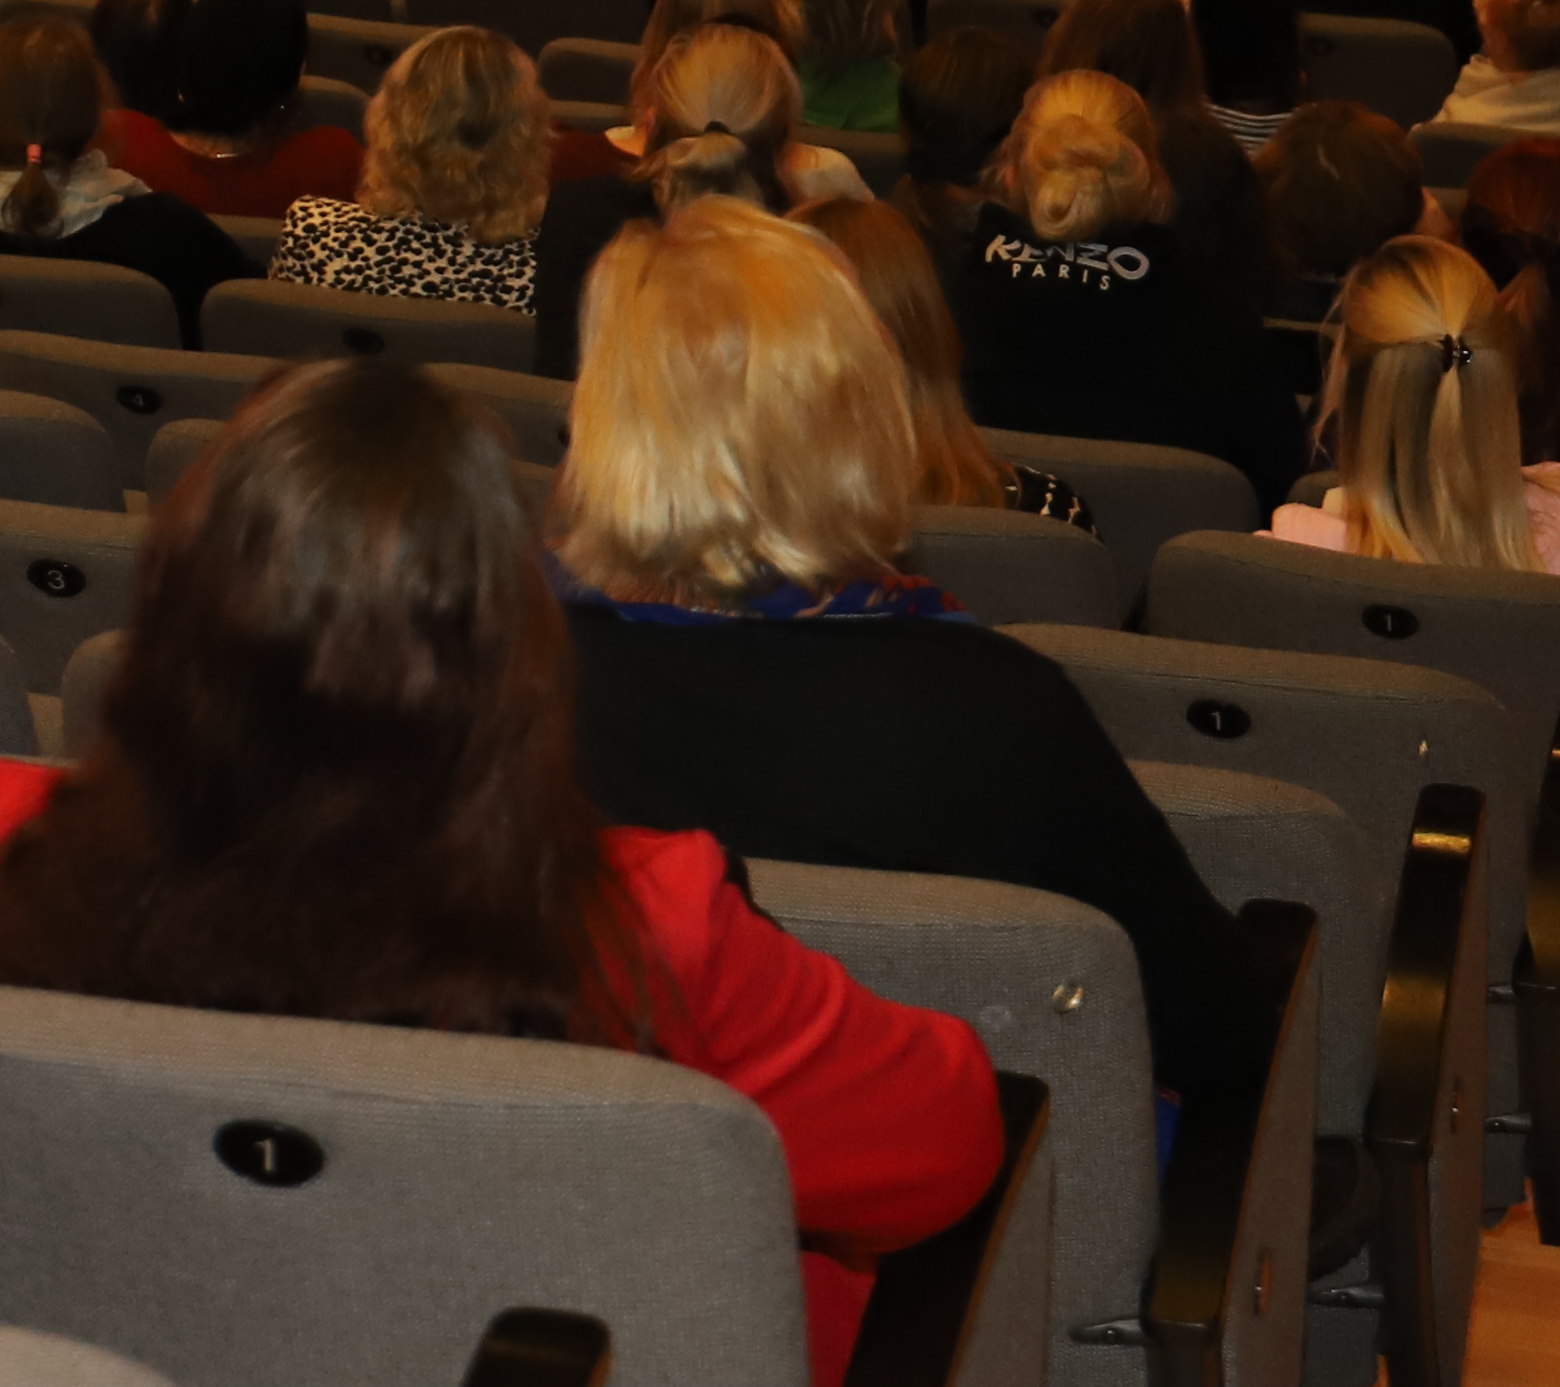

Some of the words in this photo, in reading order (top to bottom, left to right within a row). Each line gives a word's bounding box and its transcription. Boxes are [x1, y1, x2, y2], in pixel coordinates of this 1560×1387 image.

[1011, 262, 1111, 291] PARIS
[47, 569, 66, 590] 3
[253, 1136, 277, 1174] 1
